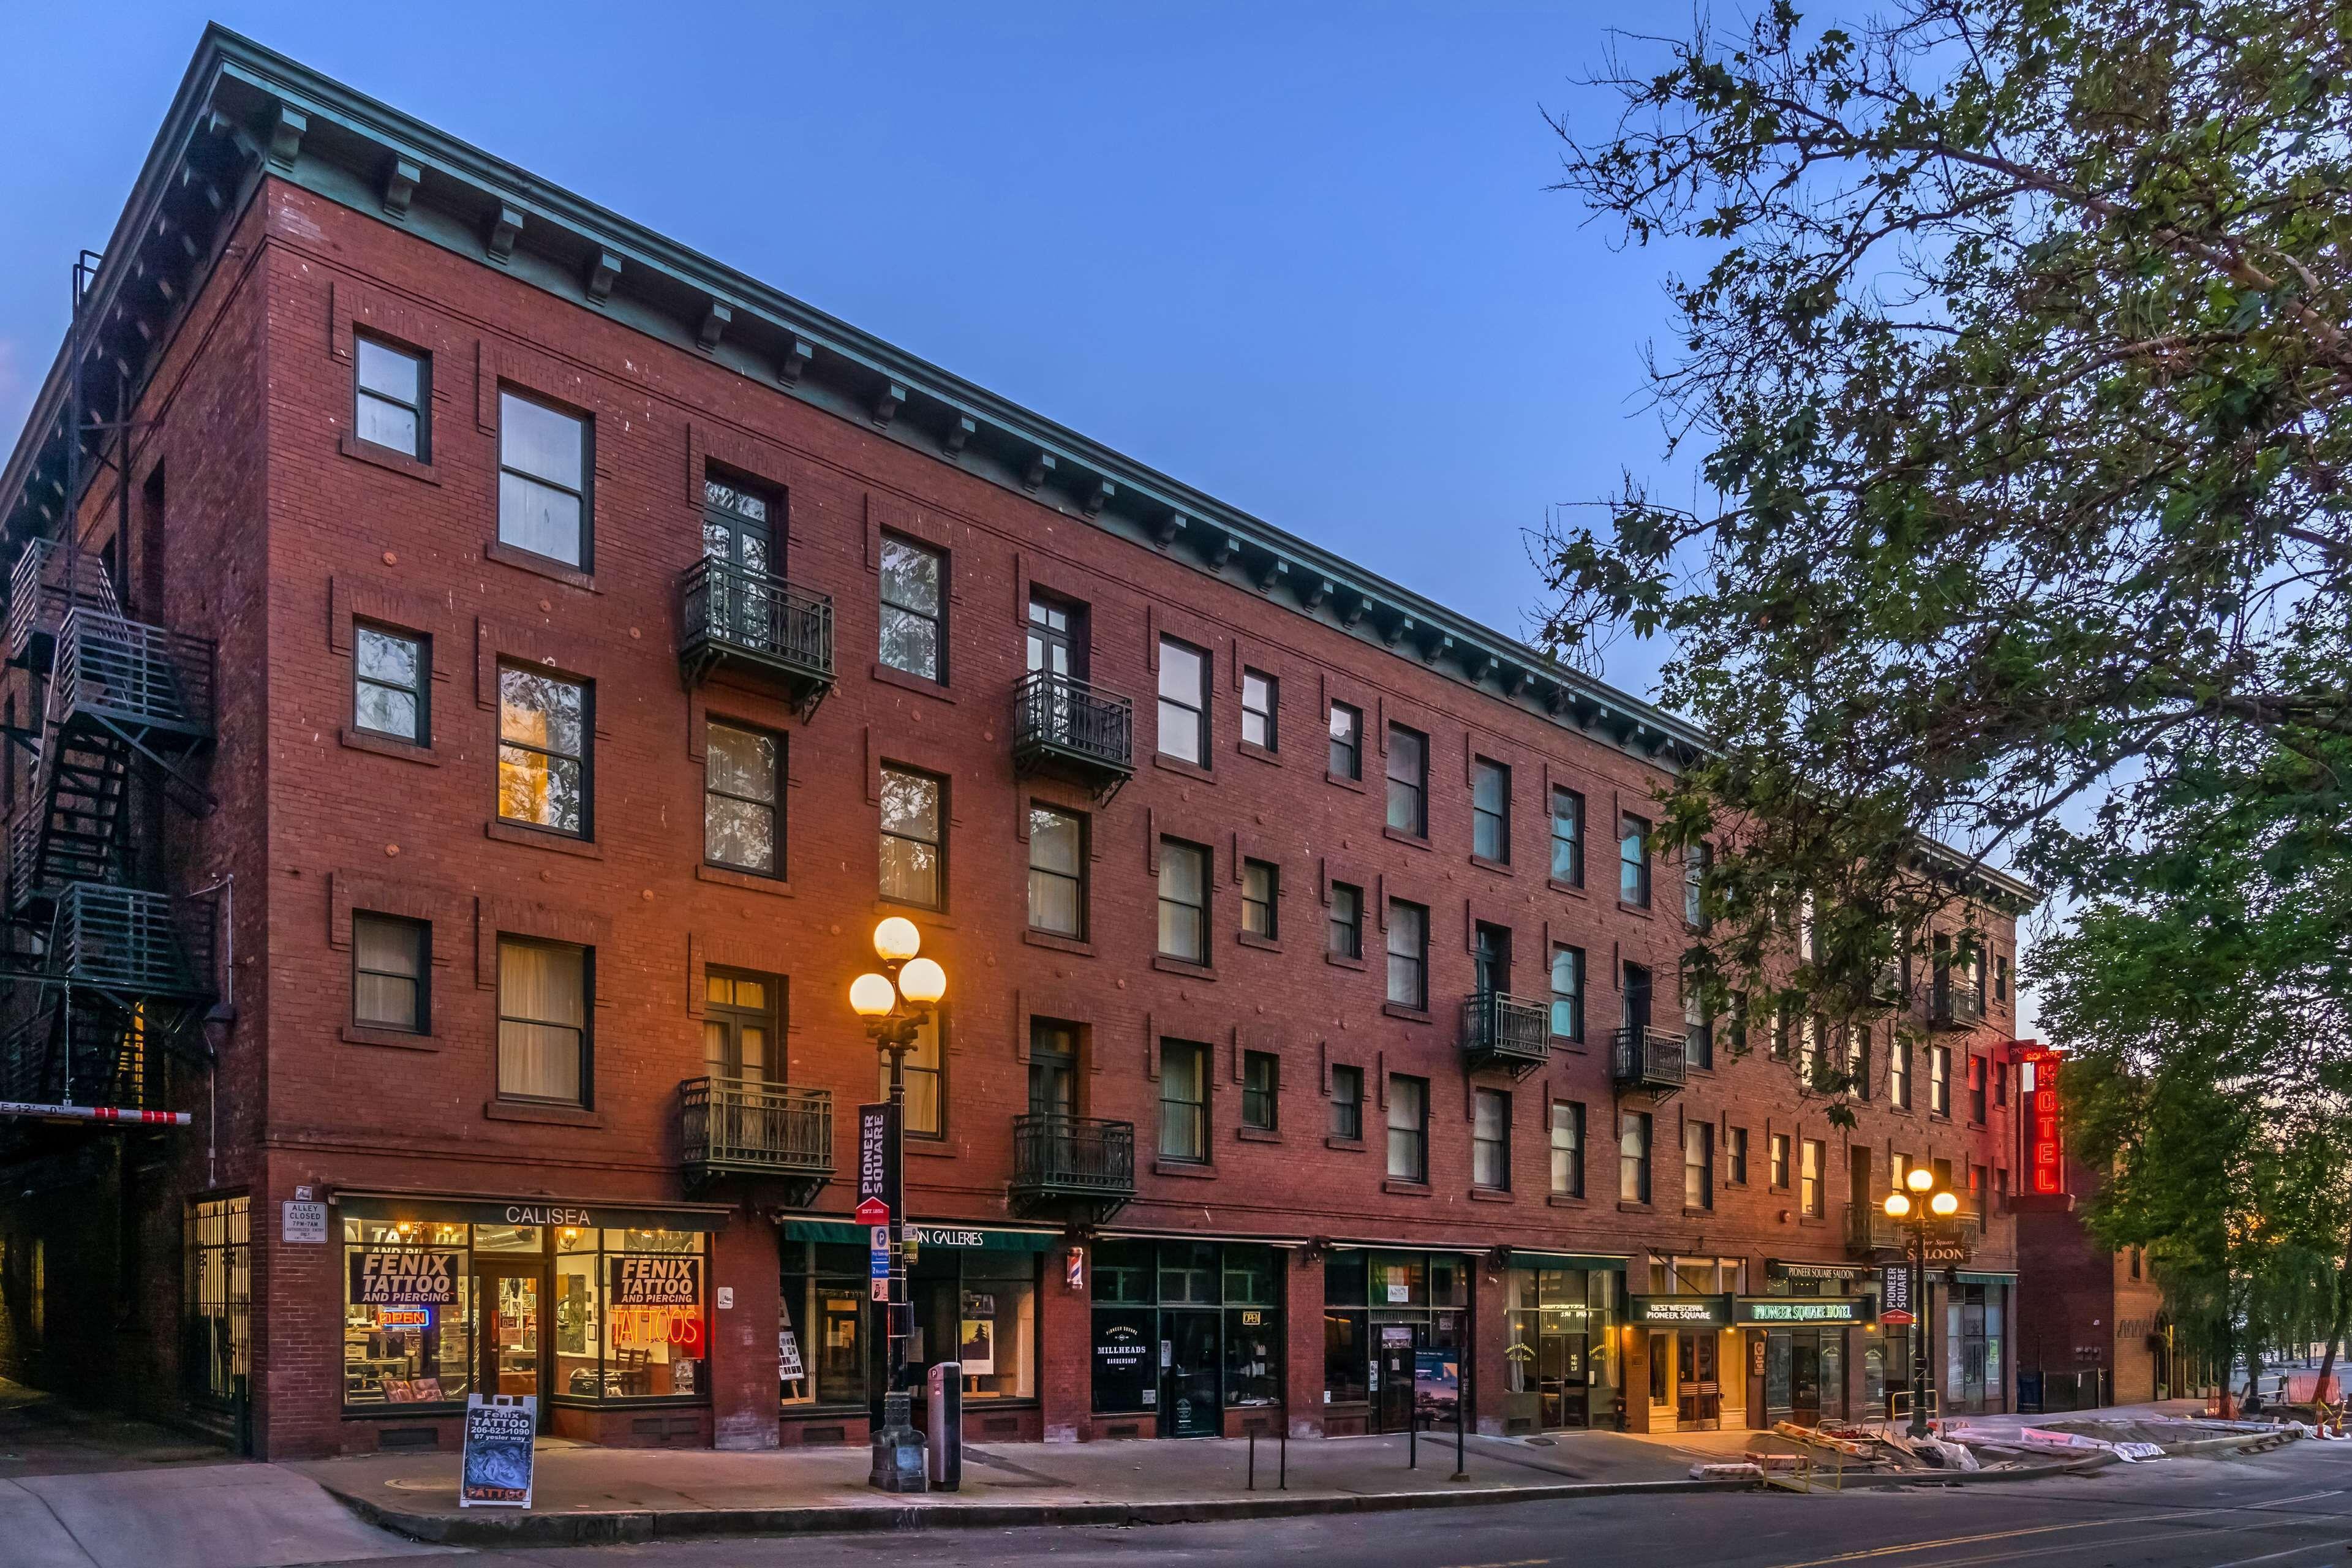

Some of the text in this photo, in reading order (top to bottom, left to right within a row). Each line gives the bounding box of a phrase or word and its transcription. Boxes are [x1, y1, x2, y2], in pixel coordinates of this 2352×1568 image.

[2039, 1066, 2054, 1189] HOTEL
[862, 1115, 873, 1194] PIONEER
[873, 1114, 884, 1194] SQUARE
[506, 1206, 591, 1226] CALISEA
[933, 1231, 983, 1245] GALLERIES
[1907, 1248, 1964, 1261] SLOON
[363, 1254, 450, 1275] FENIX
[622, 1259, 692, 1279] FENIX
[1787, 1267, 1854, 1278] PIONEER SQUARE SALOON
[363, 1275, 450, 1293] TATTOO
[622, 1279, 693, 1295] TATTOO
[1887, 1267, 1896, 1308] PIONEER
[1897, 1267, 1907, 1308] SQUARE
[363, 1292, 450, 1302] AND PIERCING
[622, 1294, 693, 1303] AND PIERCING
[379, 1313, 425, 1324] OPEN
[1244, 1313, 1259, 1323] OPEN
[1753, 1305, 1852, 1321] PIONEER SQUARE HOTEL
[610, 1310, 697, 1344] TATTOOS
[1106, 1326, 1137, 1335] PIONEER SQUARE
[473, 1417, 529, 1428] TATTOO
[470, 1427, 530, 1435] 206-623-1090
[467, 1488, 527, 1501] TATTOO
